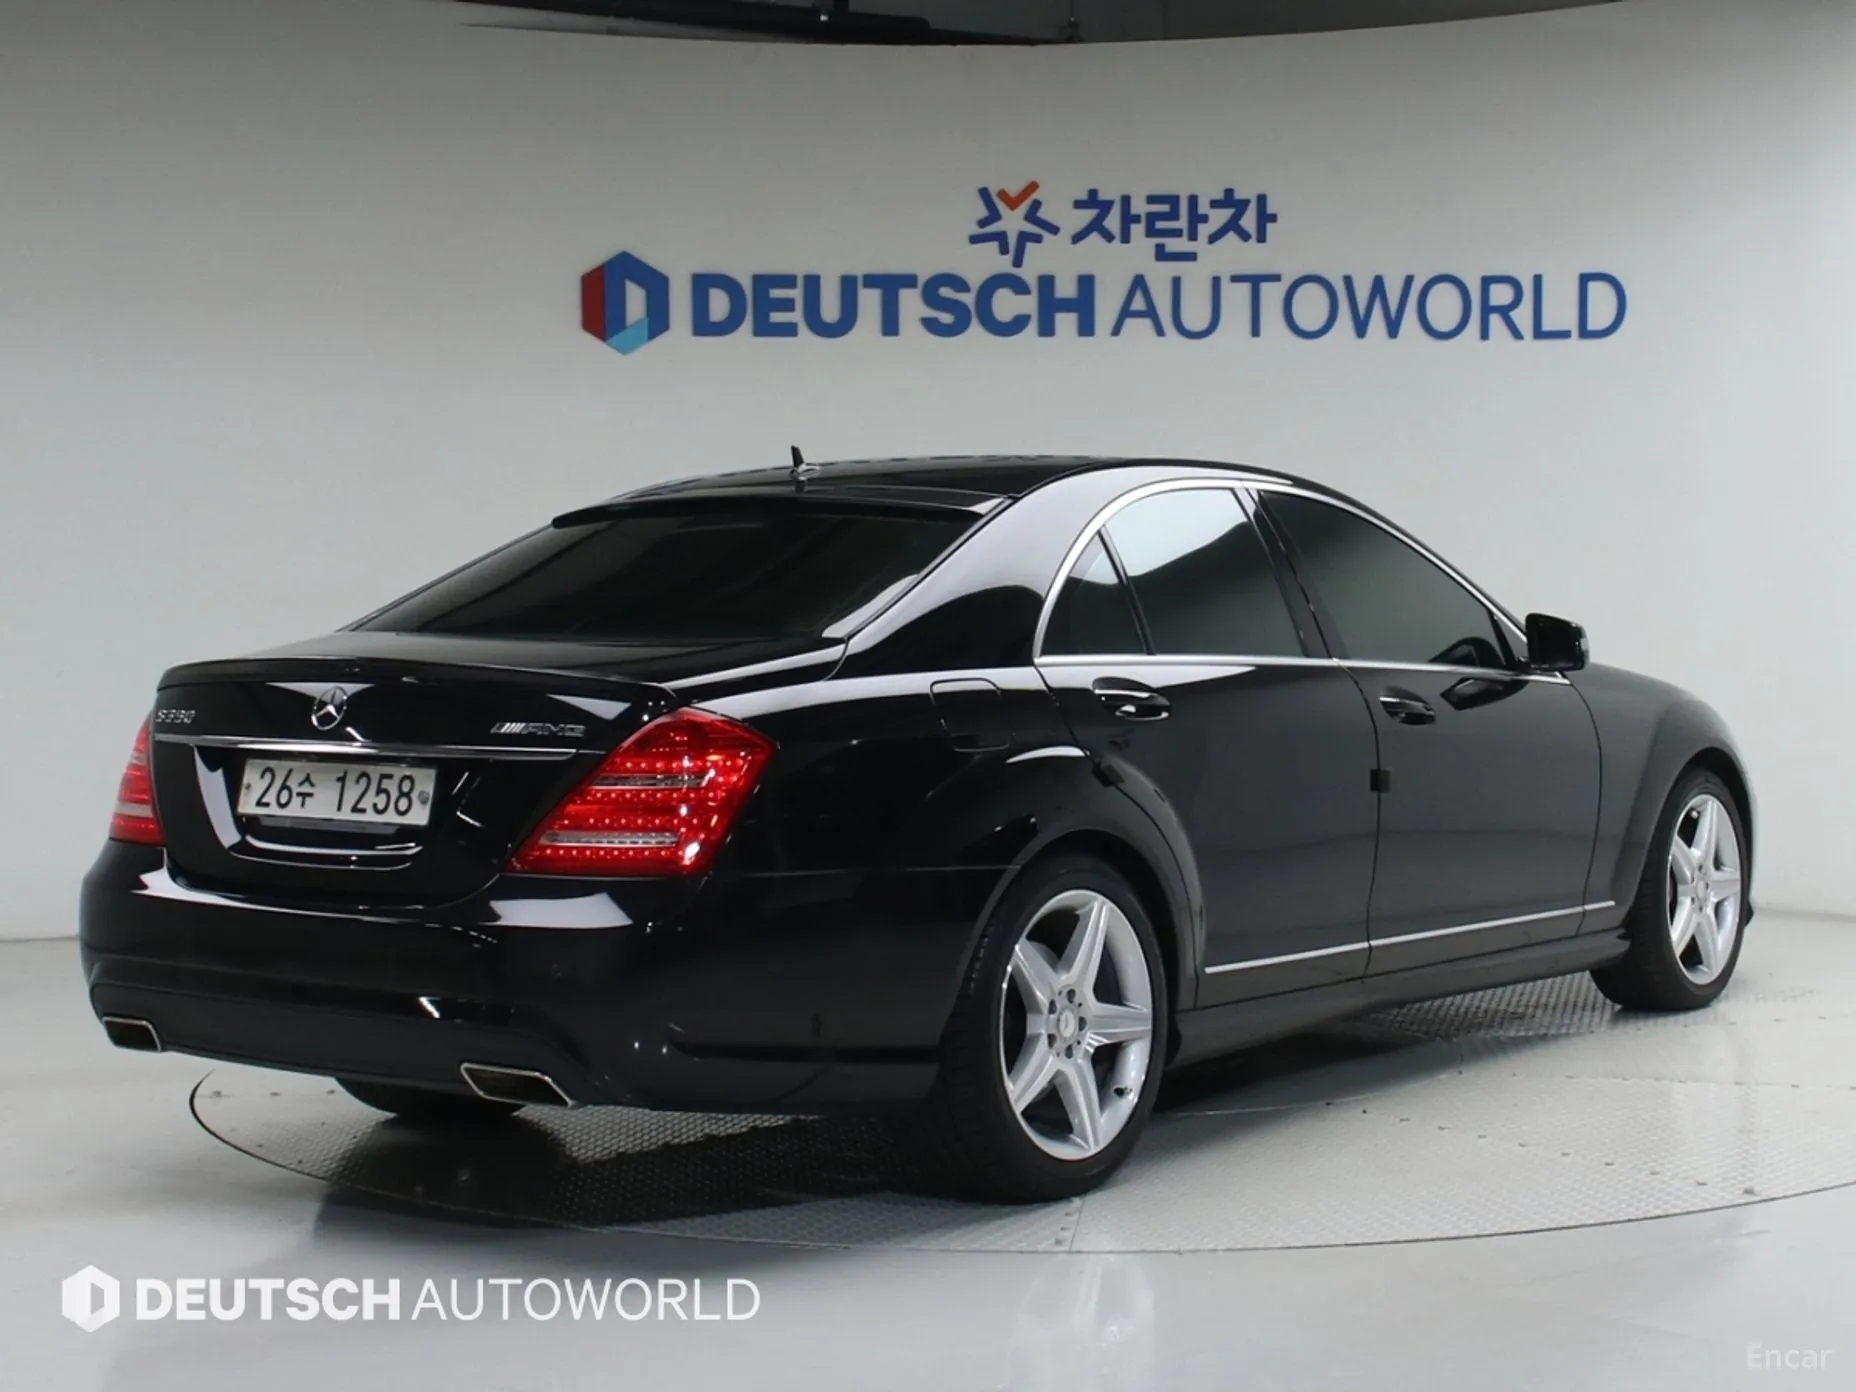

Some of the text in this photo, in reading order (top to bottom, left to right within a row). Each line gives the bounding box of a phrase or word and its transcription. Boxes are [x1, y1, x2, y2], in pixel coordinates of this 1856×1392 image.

[1071, 188, 1278, 262] 차란차
[691, 272, 1628, 342] DEUTSCH AUTOWORLD
[255, 766, 416, 817] 26수 1258
